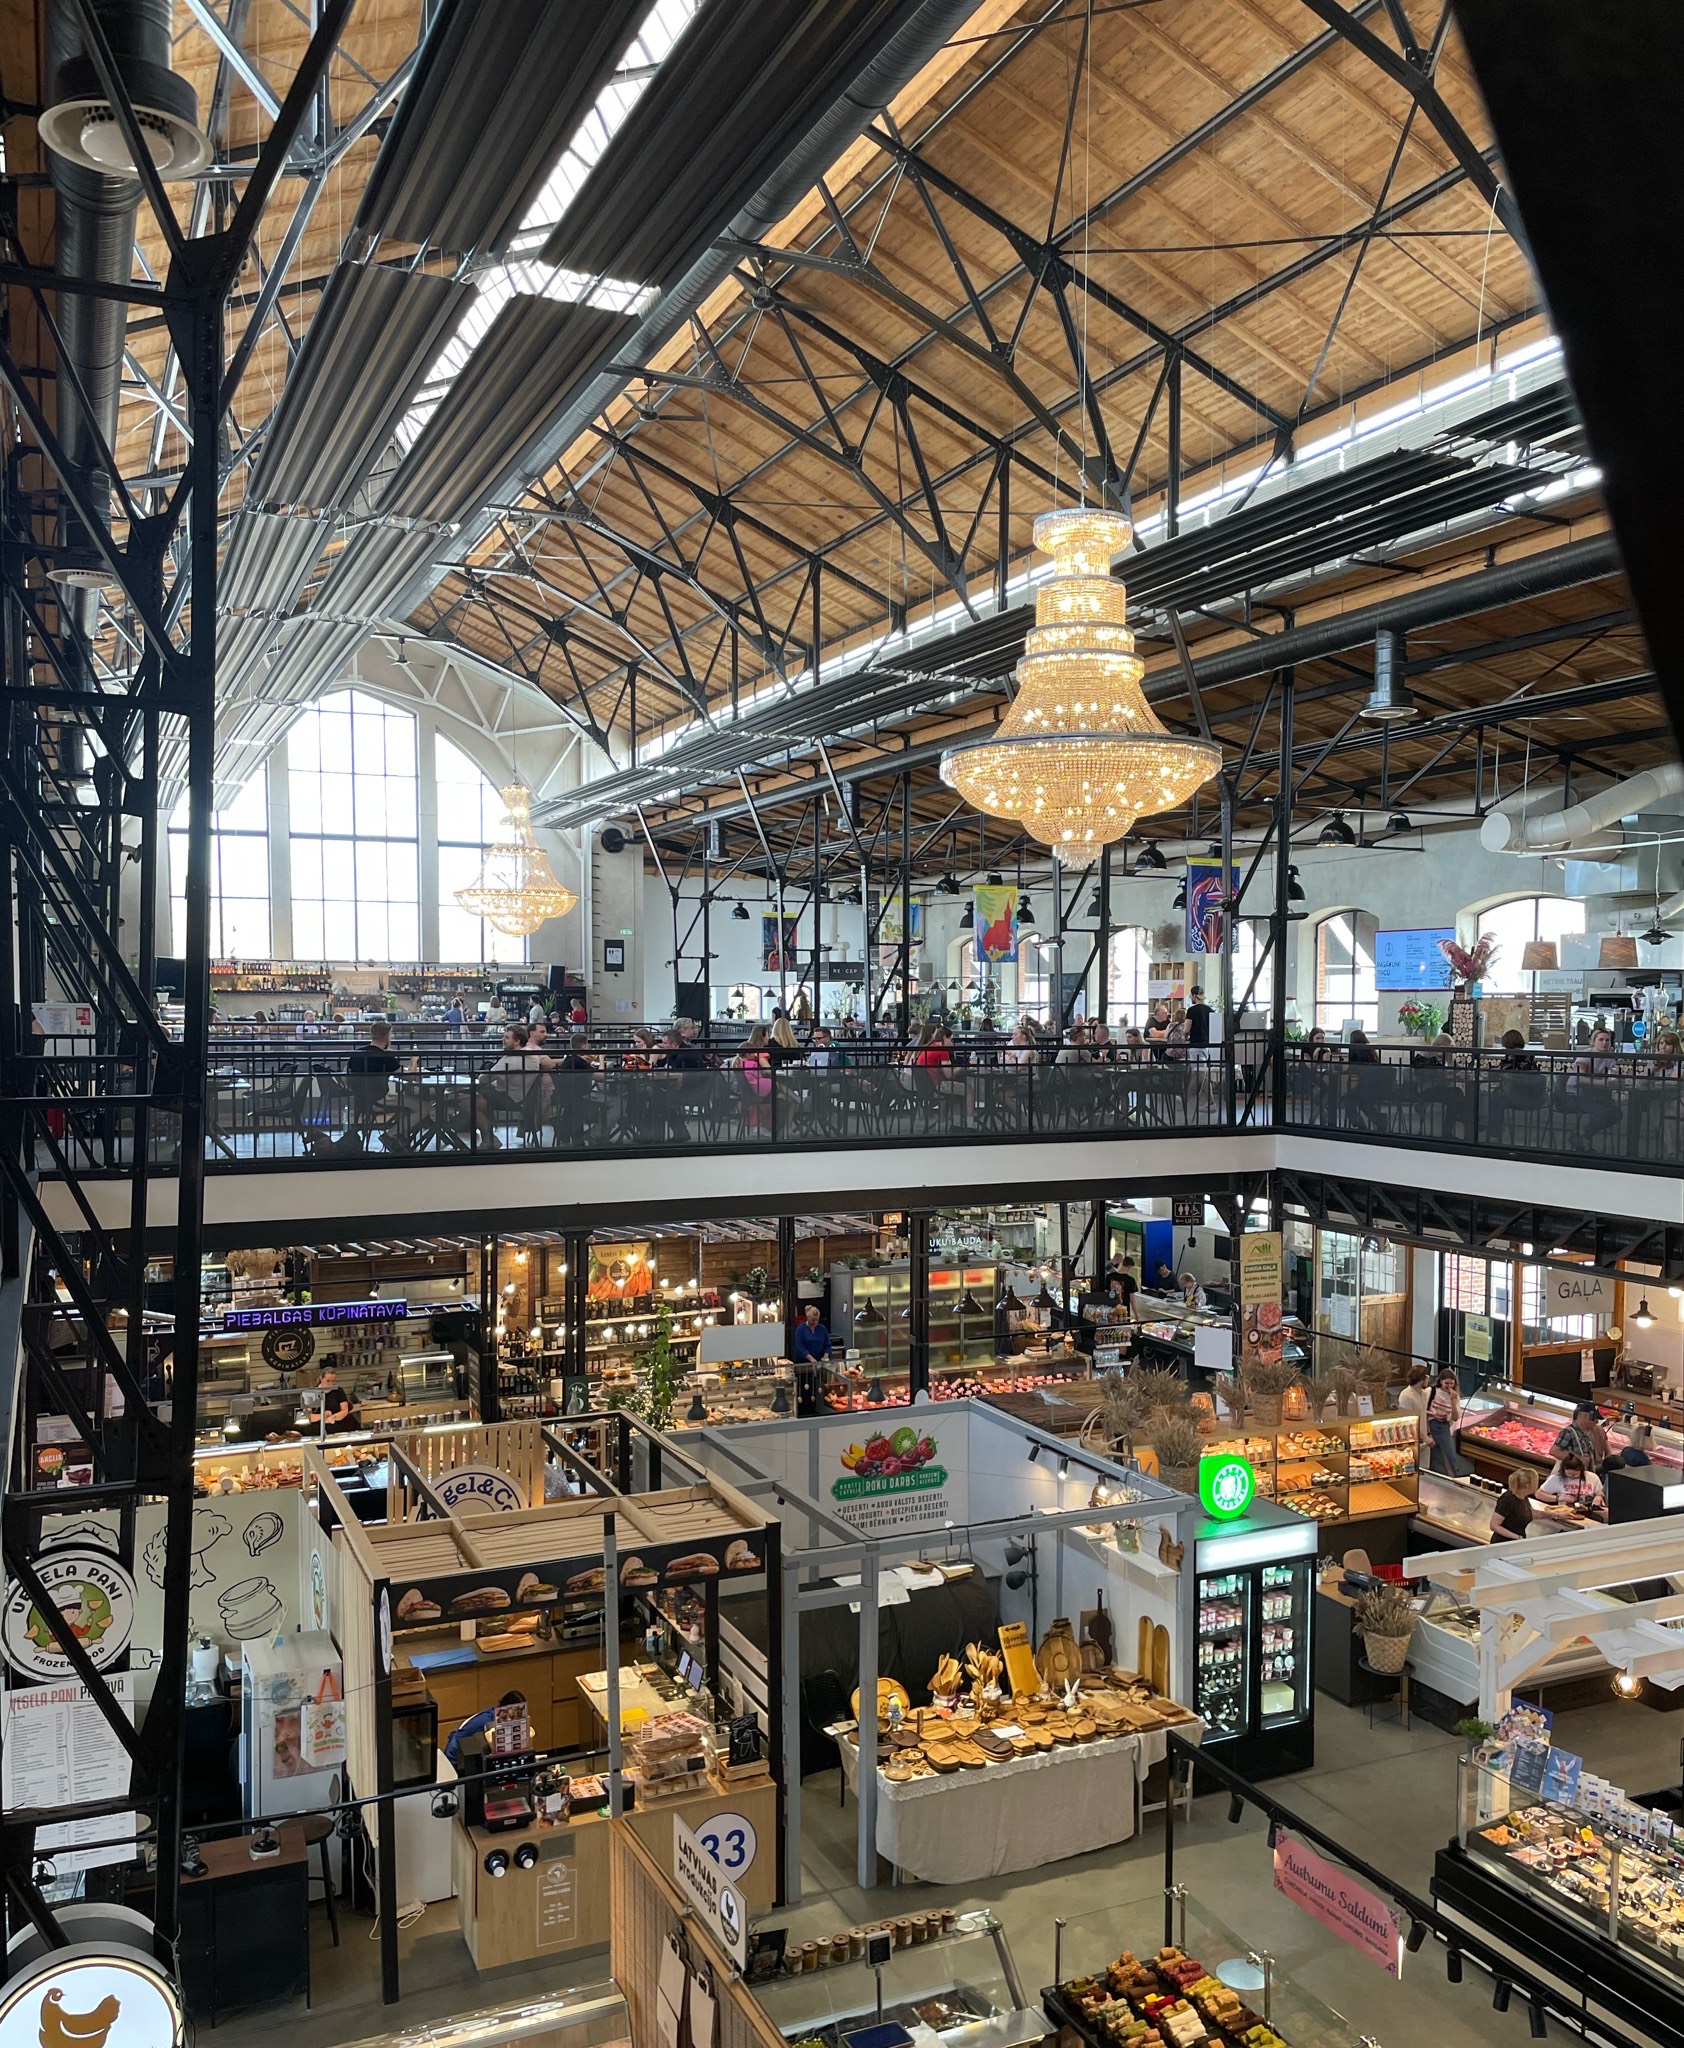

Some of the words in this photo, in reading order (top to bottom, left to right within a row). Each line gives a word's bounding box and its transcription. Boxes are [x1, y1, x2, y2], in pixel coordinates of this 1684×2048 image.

[226, 1309, 312, 1328] PIEBALGAS
[318, 1304, 406, 1321] KŪPINĀTAVA
[40, 1453, 63, 1464] AKCIJA
[865, 1479, 887, 1492] ROKU
[889, 1475, 915, 1488] DARBS
[842, 1503, 869, 1513] DESERTI
[894, 1496, 915, 1507] VALSTS
[917, 1493, 942, 1503] DESERTI
[858, 1510, 883, 1521] JOGURTI
[923, 1500, 949, 1511] DESERTI
[87, 1567, 123, 1600] PANI
[10, 1692, 47, 1711] VESELA
[51, 1687, 77, 1704] PANI
[678, 1834, 717, 1895] LATVIJAS
[678, 1857, 717, 1915] produkcija
[1284, 1855, 1336, 1901] Austrumu
[1338, 1891, 1388, 1939] Saldumi
